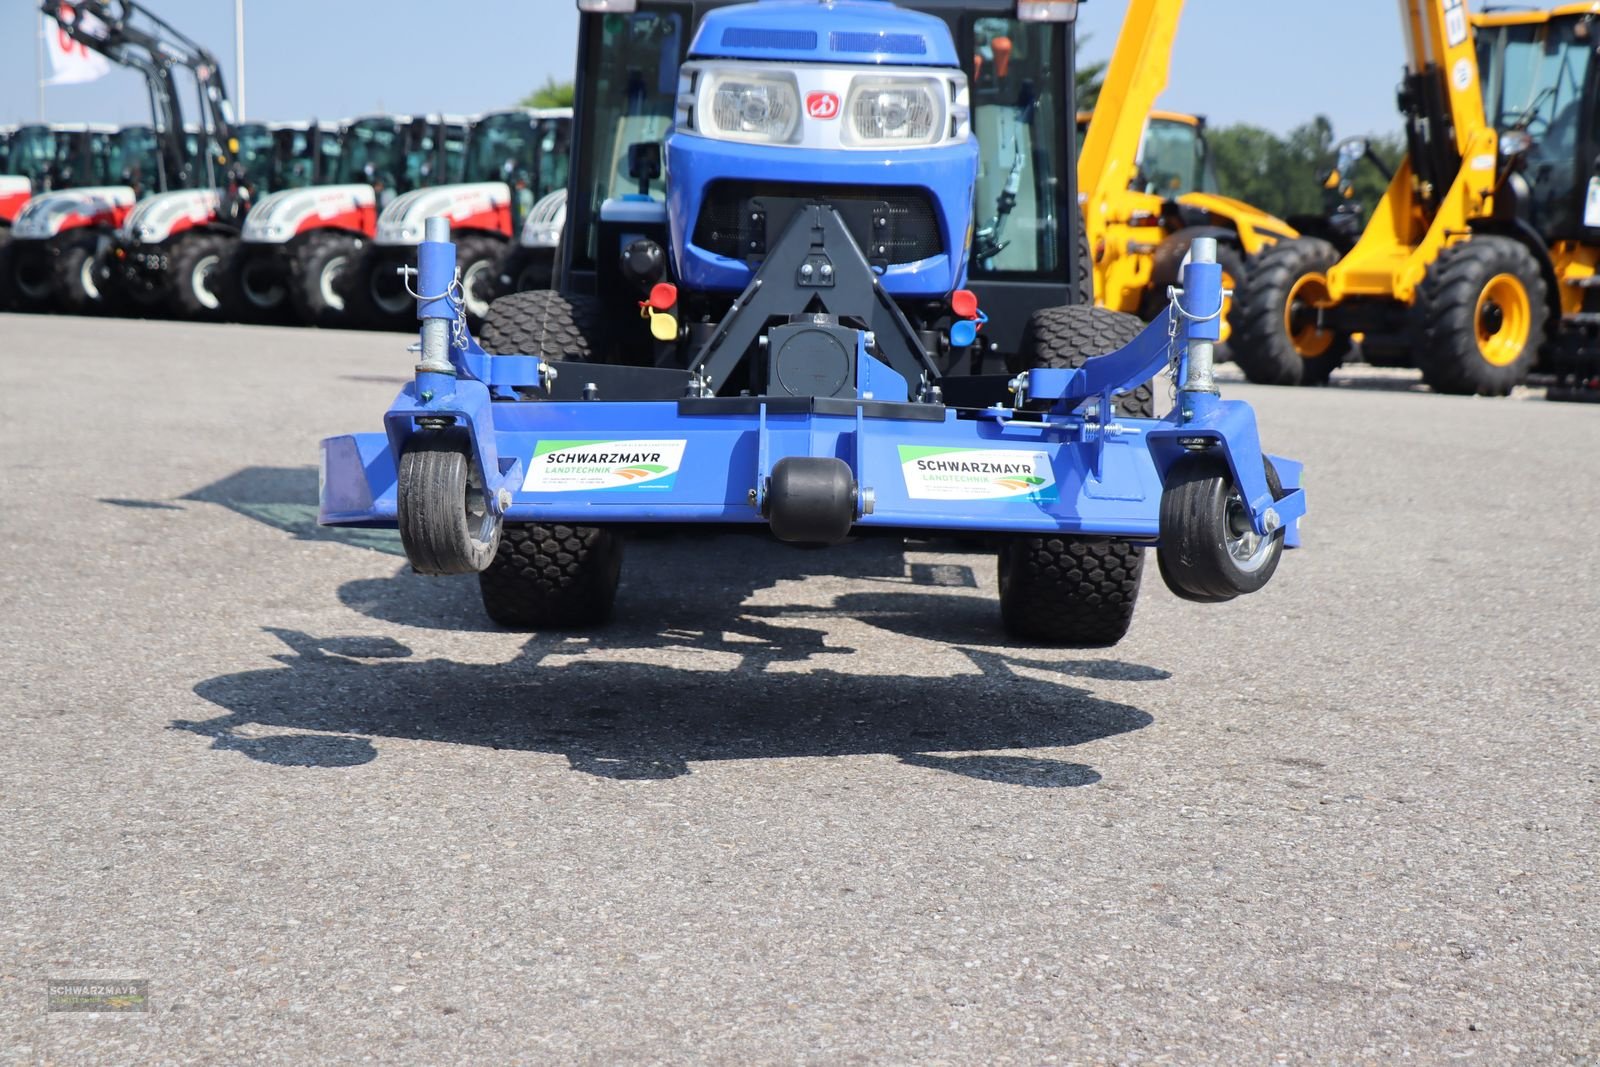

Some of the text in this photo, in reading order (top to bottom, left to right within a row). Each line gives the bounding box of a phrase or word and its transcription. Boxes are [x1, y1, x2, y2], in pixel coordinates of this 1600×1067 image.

[546, 453, 661, 464] SCHWARZMAYR
[545, 466, 611, 474] LANDTECHNIK
[917, 460, 1032, 474] SCHWARZMAYR
[922, 474, 990, 483] LANDTECHNIK
